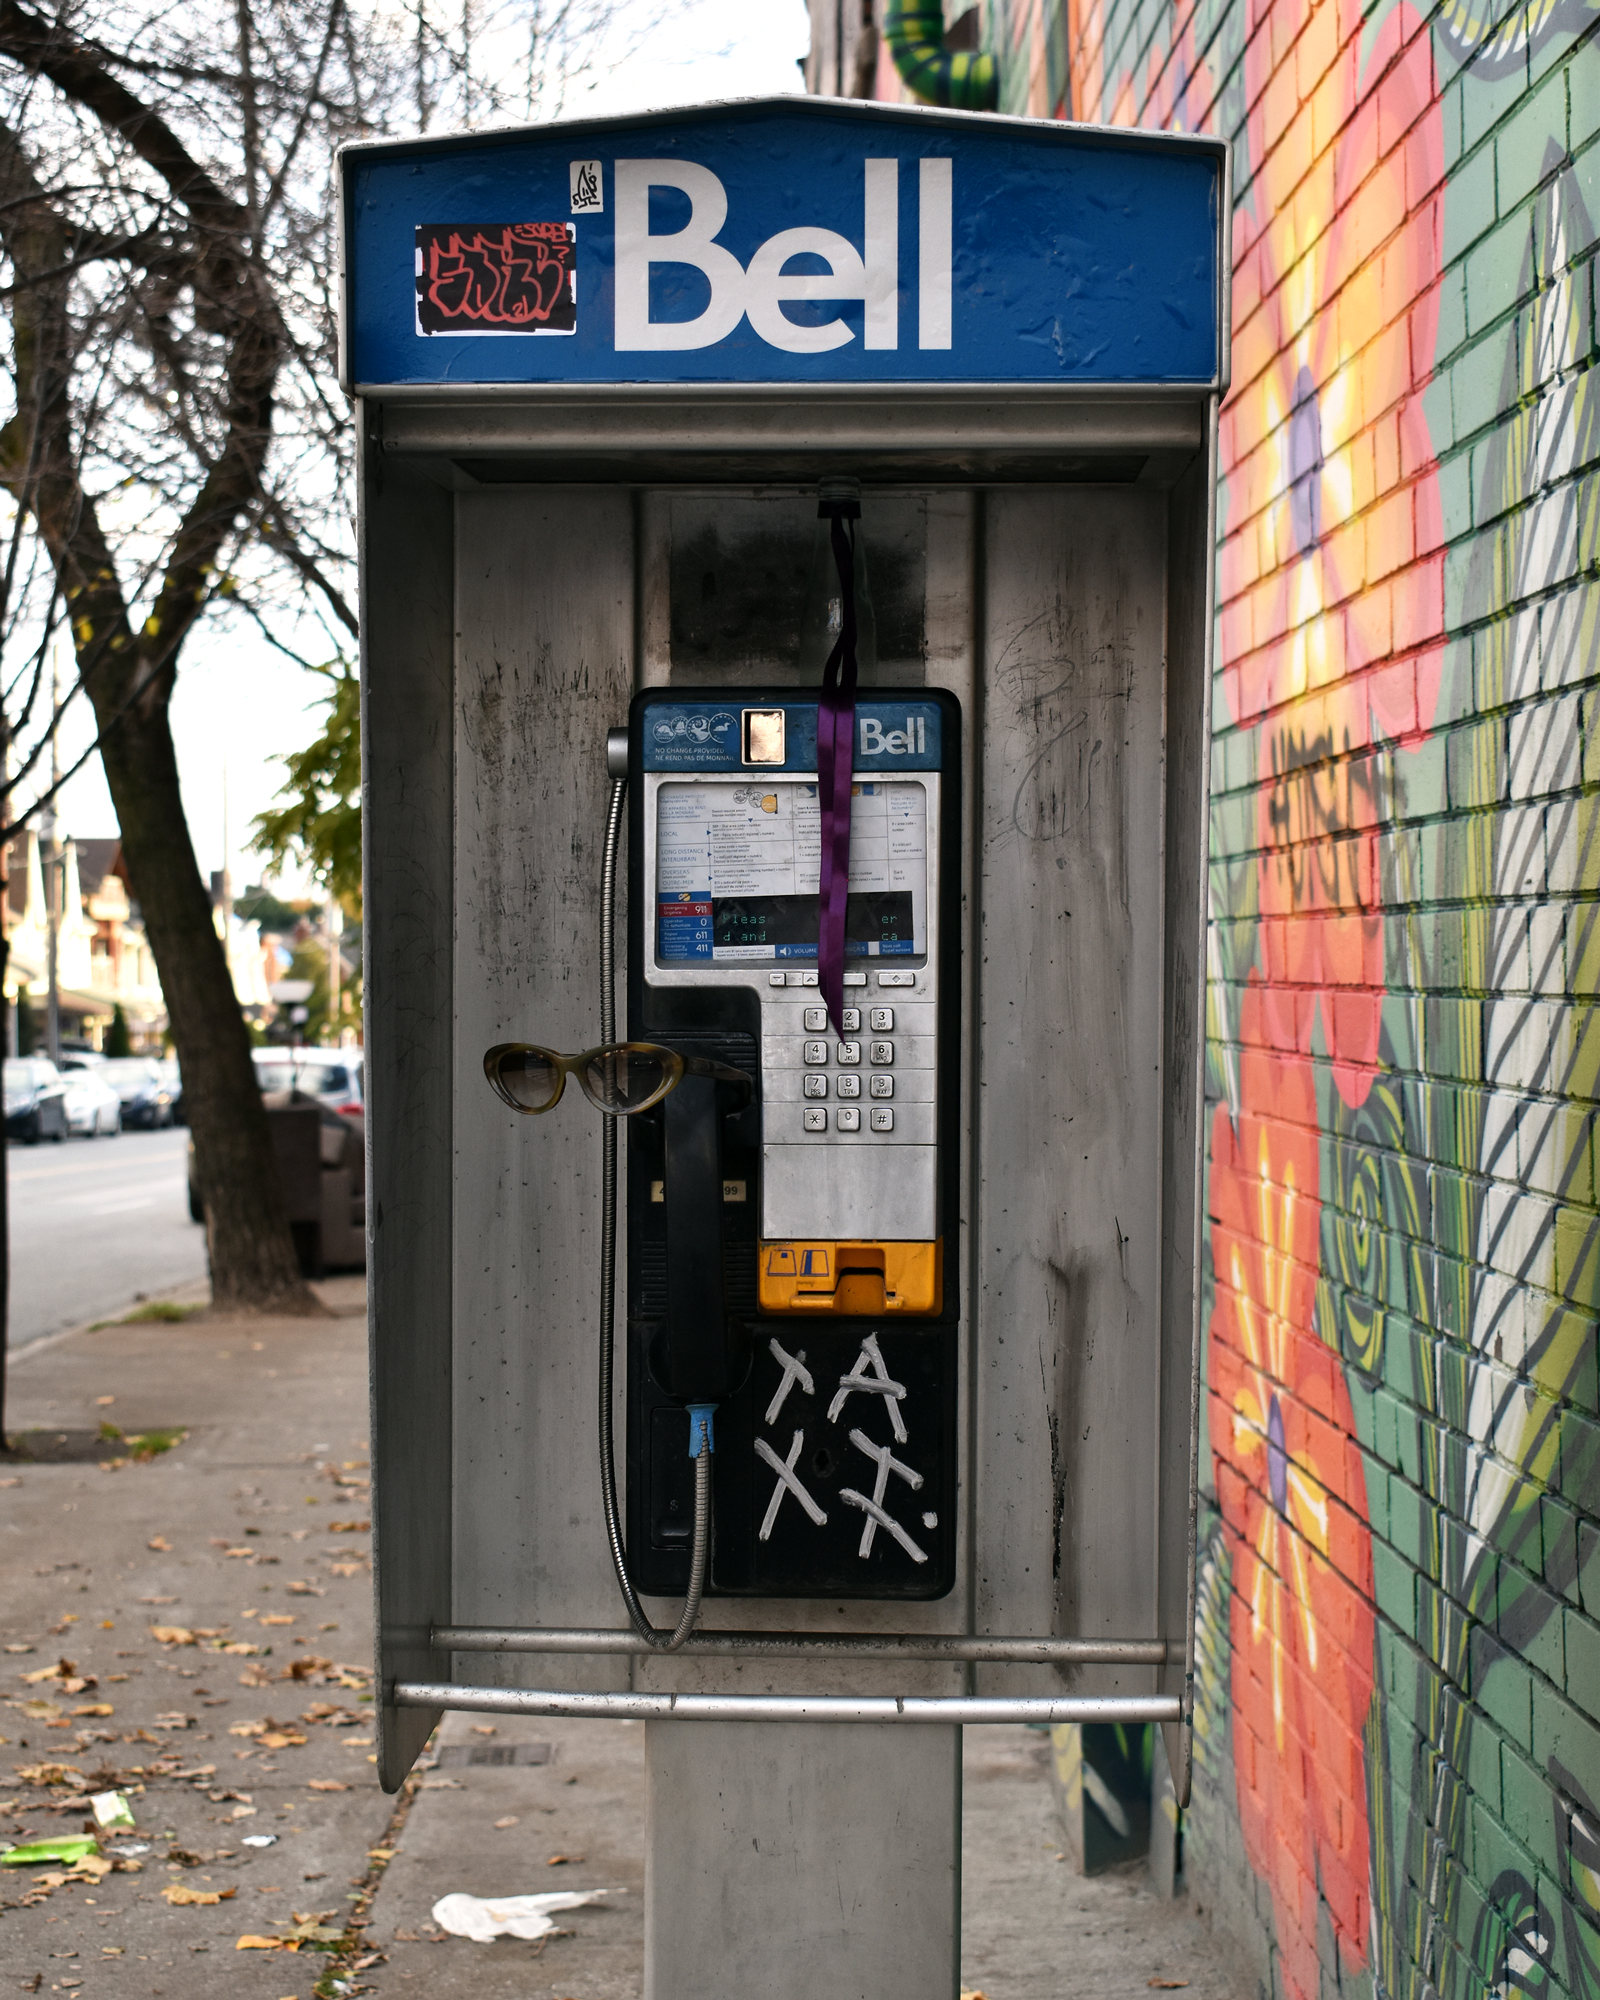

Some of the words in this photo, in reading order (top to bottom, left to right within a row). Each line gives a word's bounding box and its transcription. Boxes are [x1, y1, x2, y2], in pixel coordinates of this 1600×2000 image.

[614, 157, 952, 354] Bell
[860, 716, 925, 755] Bell
[700, 918, 707, 926] 0
[882, 915, 897, 924] er
[696, 931, 707, 940] 611
[723, 931, 730, 941] d
[741, 930, 766, 941] and
[814, 1012, 818, 1020] 1
[846, 1012, 852, 1020] 2
[879, 1012, 885, 1020] 3
[812, 1045, 819, 1053] 4
[846, 1045, 852, 1053] 5
[878, 1045, 885, 1053] 6
[813, 1078, 819, 1087] 7
[846, 1078, 852, 1087] 8
[878, 1078, 885, 1087] 9
[845, 1112, 852, 1120] 0
[724, 1186, 738, 1195] 99
